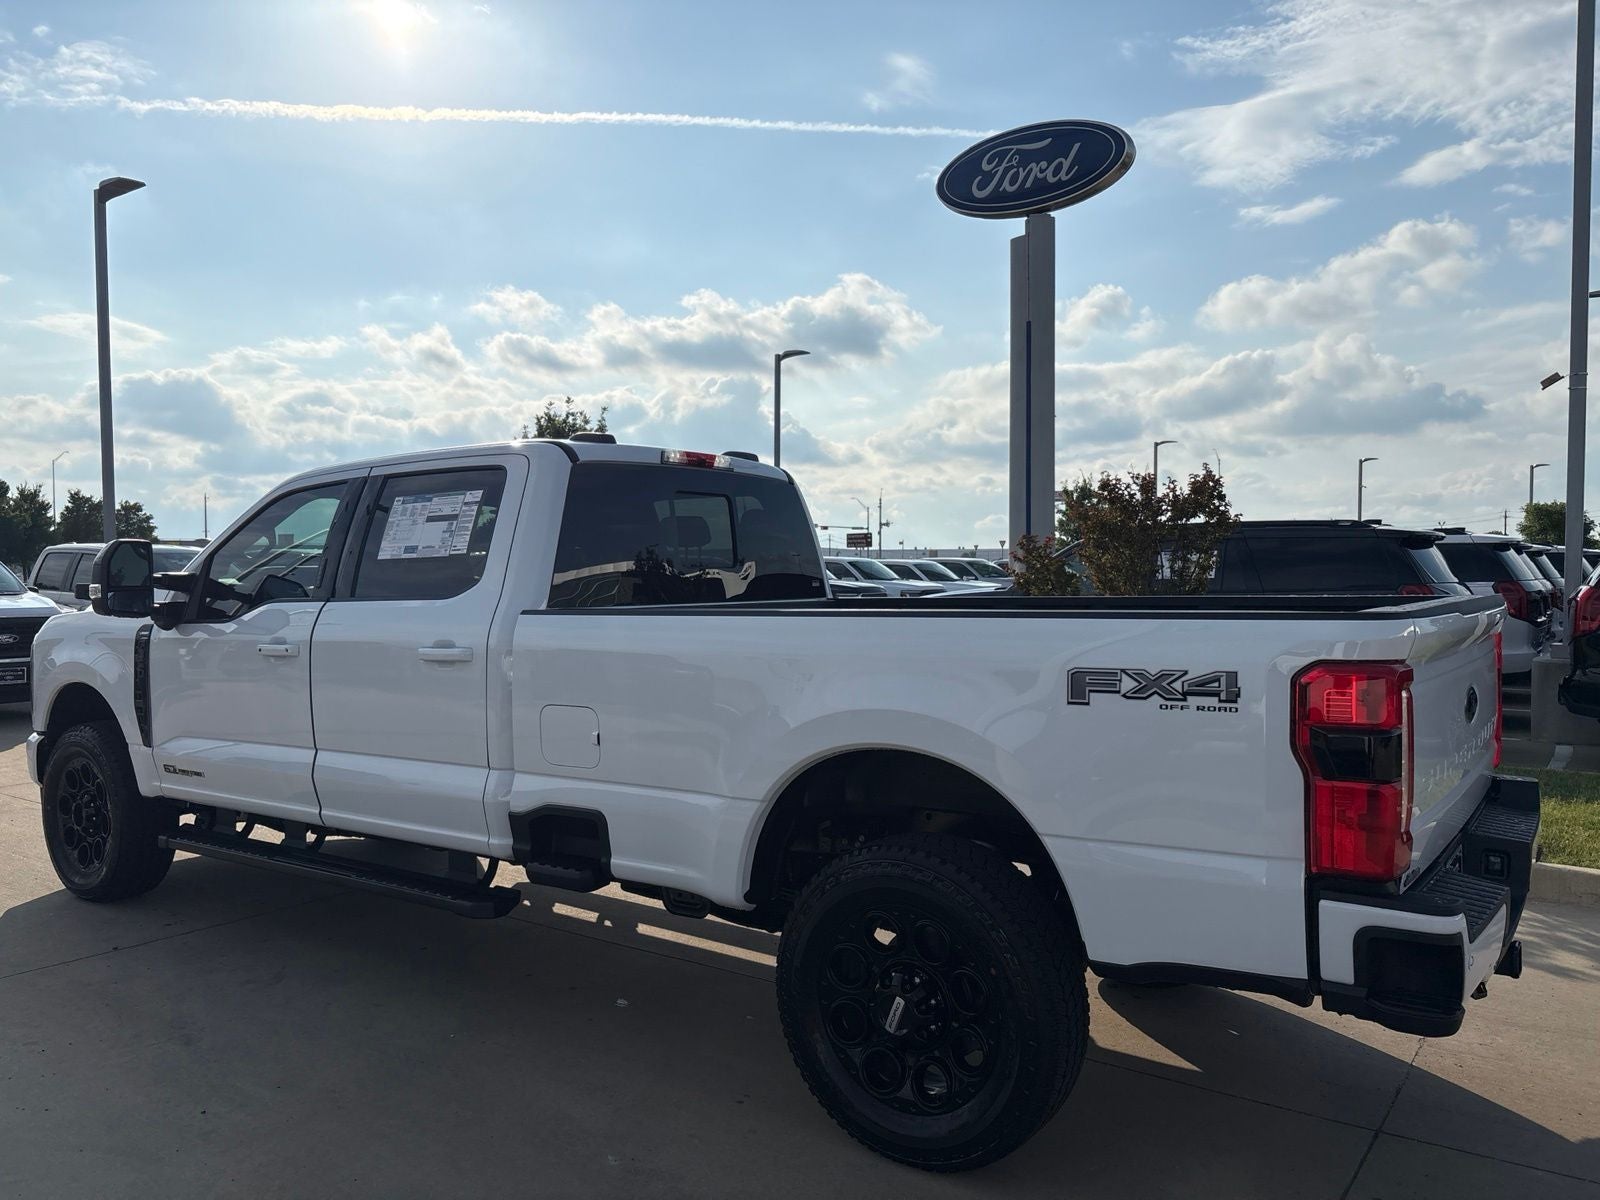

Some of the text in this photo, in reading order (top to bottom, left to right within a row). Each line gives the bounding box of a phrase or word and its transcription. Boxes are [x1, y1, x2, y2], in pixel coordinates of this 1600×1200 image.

[972, 138, 1081, 198] Ford
[1067, 667, 1241, 705] FX4
[1196, 705, 1239, 713] ROAD
